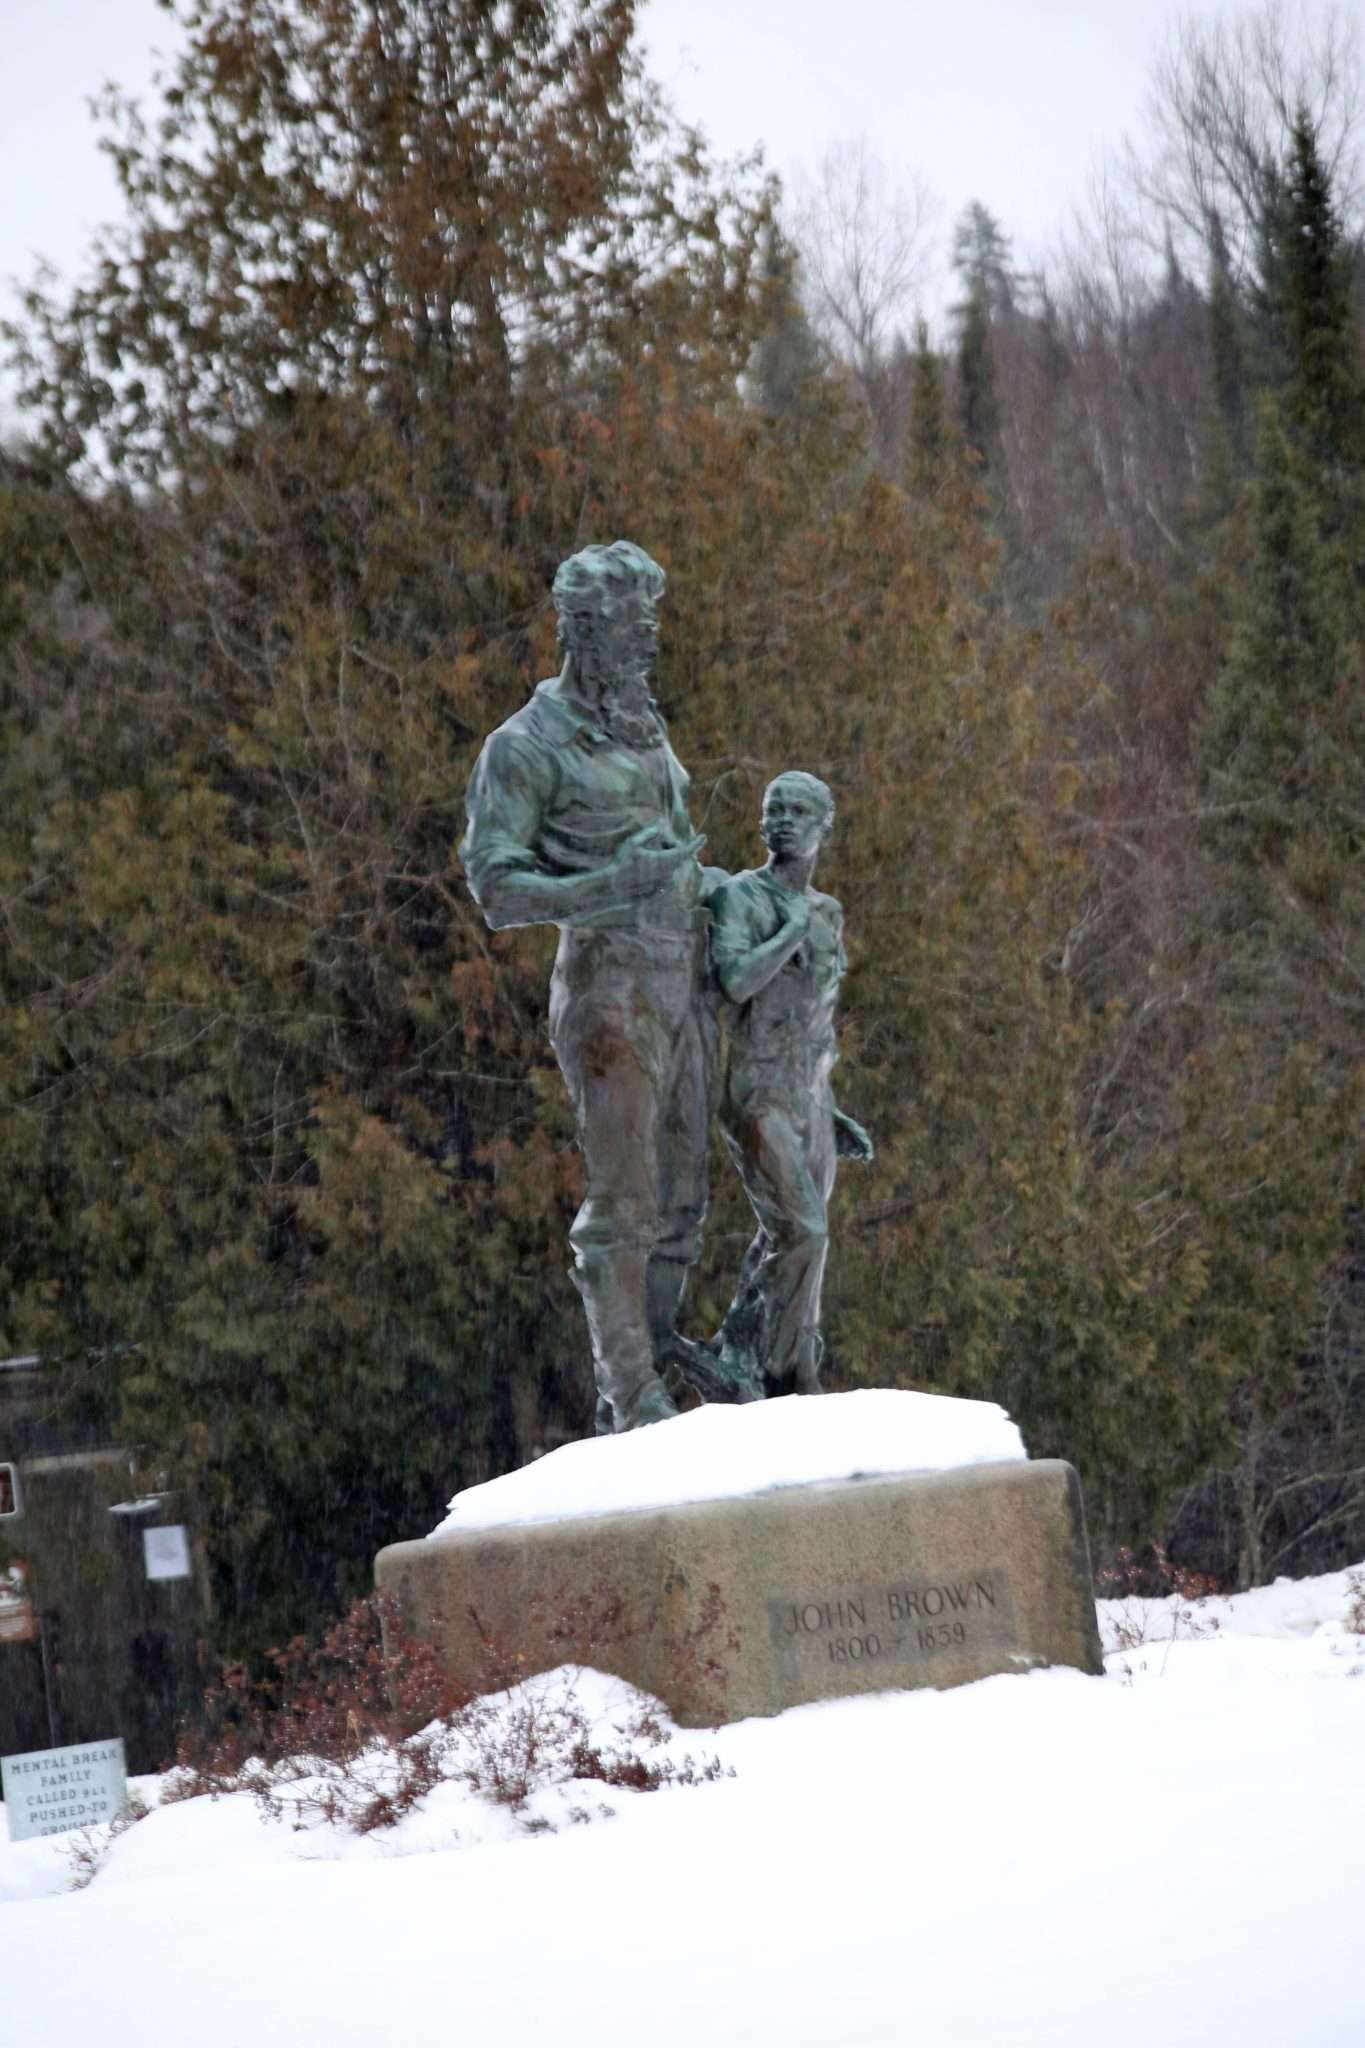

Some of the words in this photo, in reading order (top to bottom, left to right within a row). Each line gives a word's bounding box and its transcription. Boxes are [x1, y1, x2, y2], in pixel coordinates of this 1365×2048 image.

[783, 1600, 867, 1635] JOHN
[887, 1580, 998, 1622] BROWN
[827, 1633, 882, 1663] 1800
[916, 1622, 967, 1650] 1859
[11, 1757, 67, 1775] MENTAL
[72, 1749, 119, 1765] BREAK
[40, 1770, 92, 1788] FAMILY
[26, 1789, 77, 1806] CALLED
